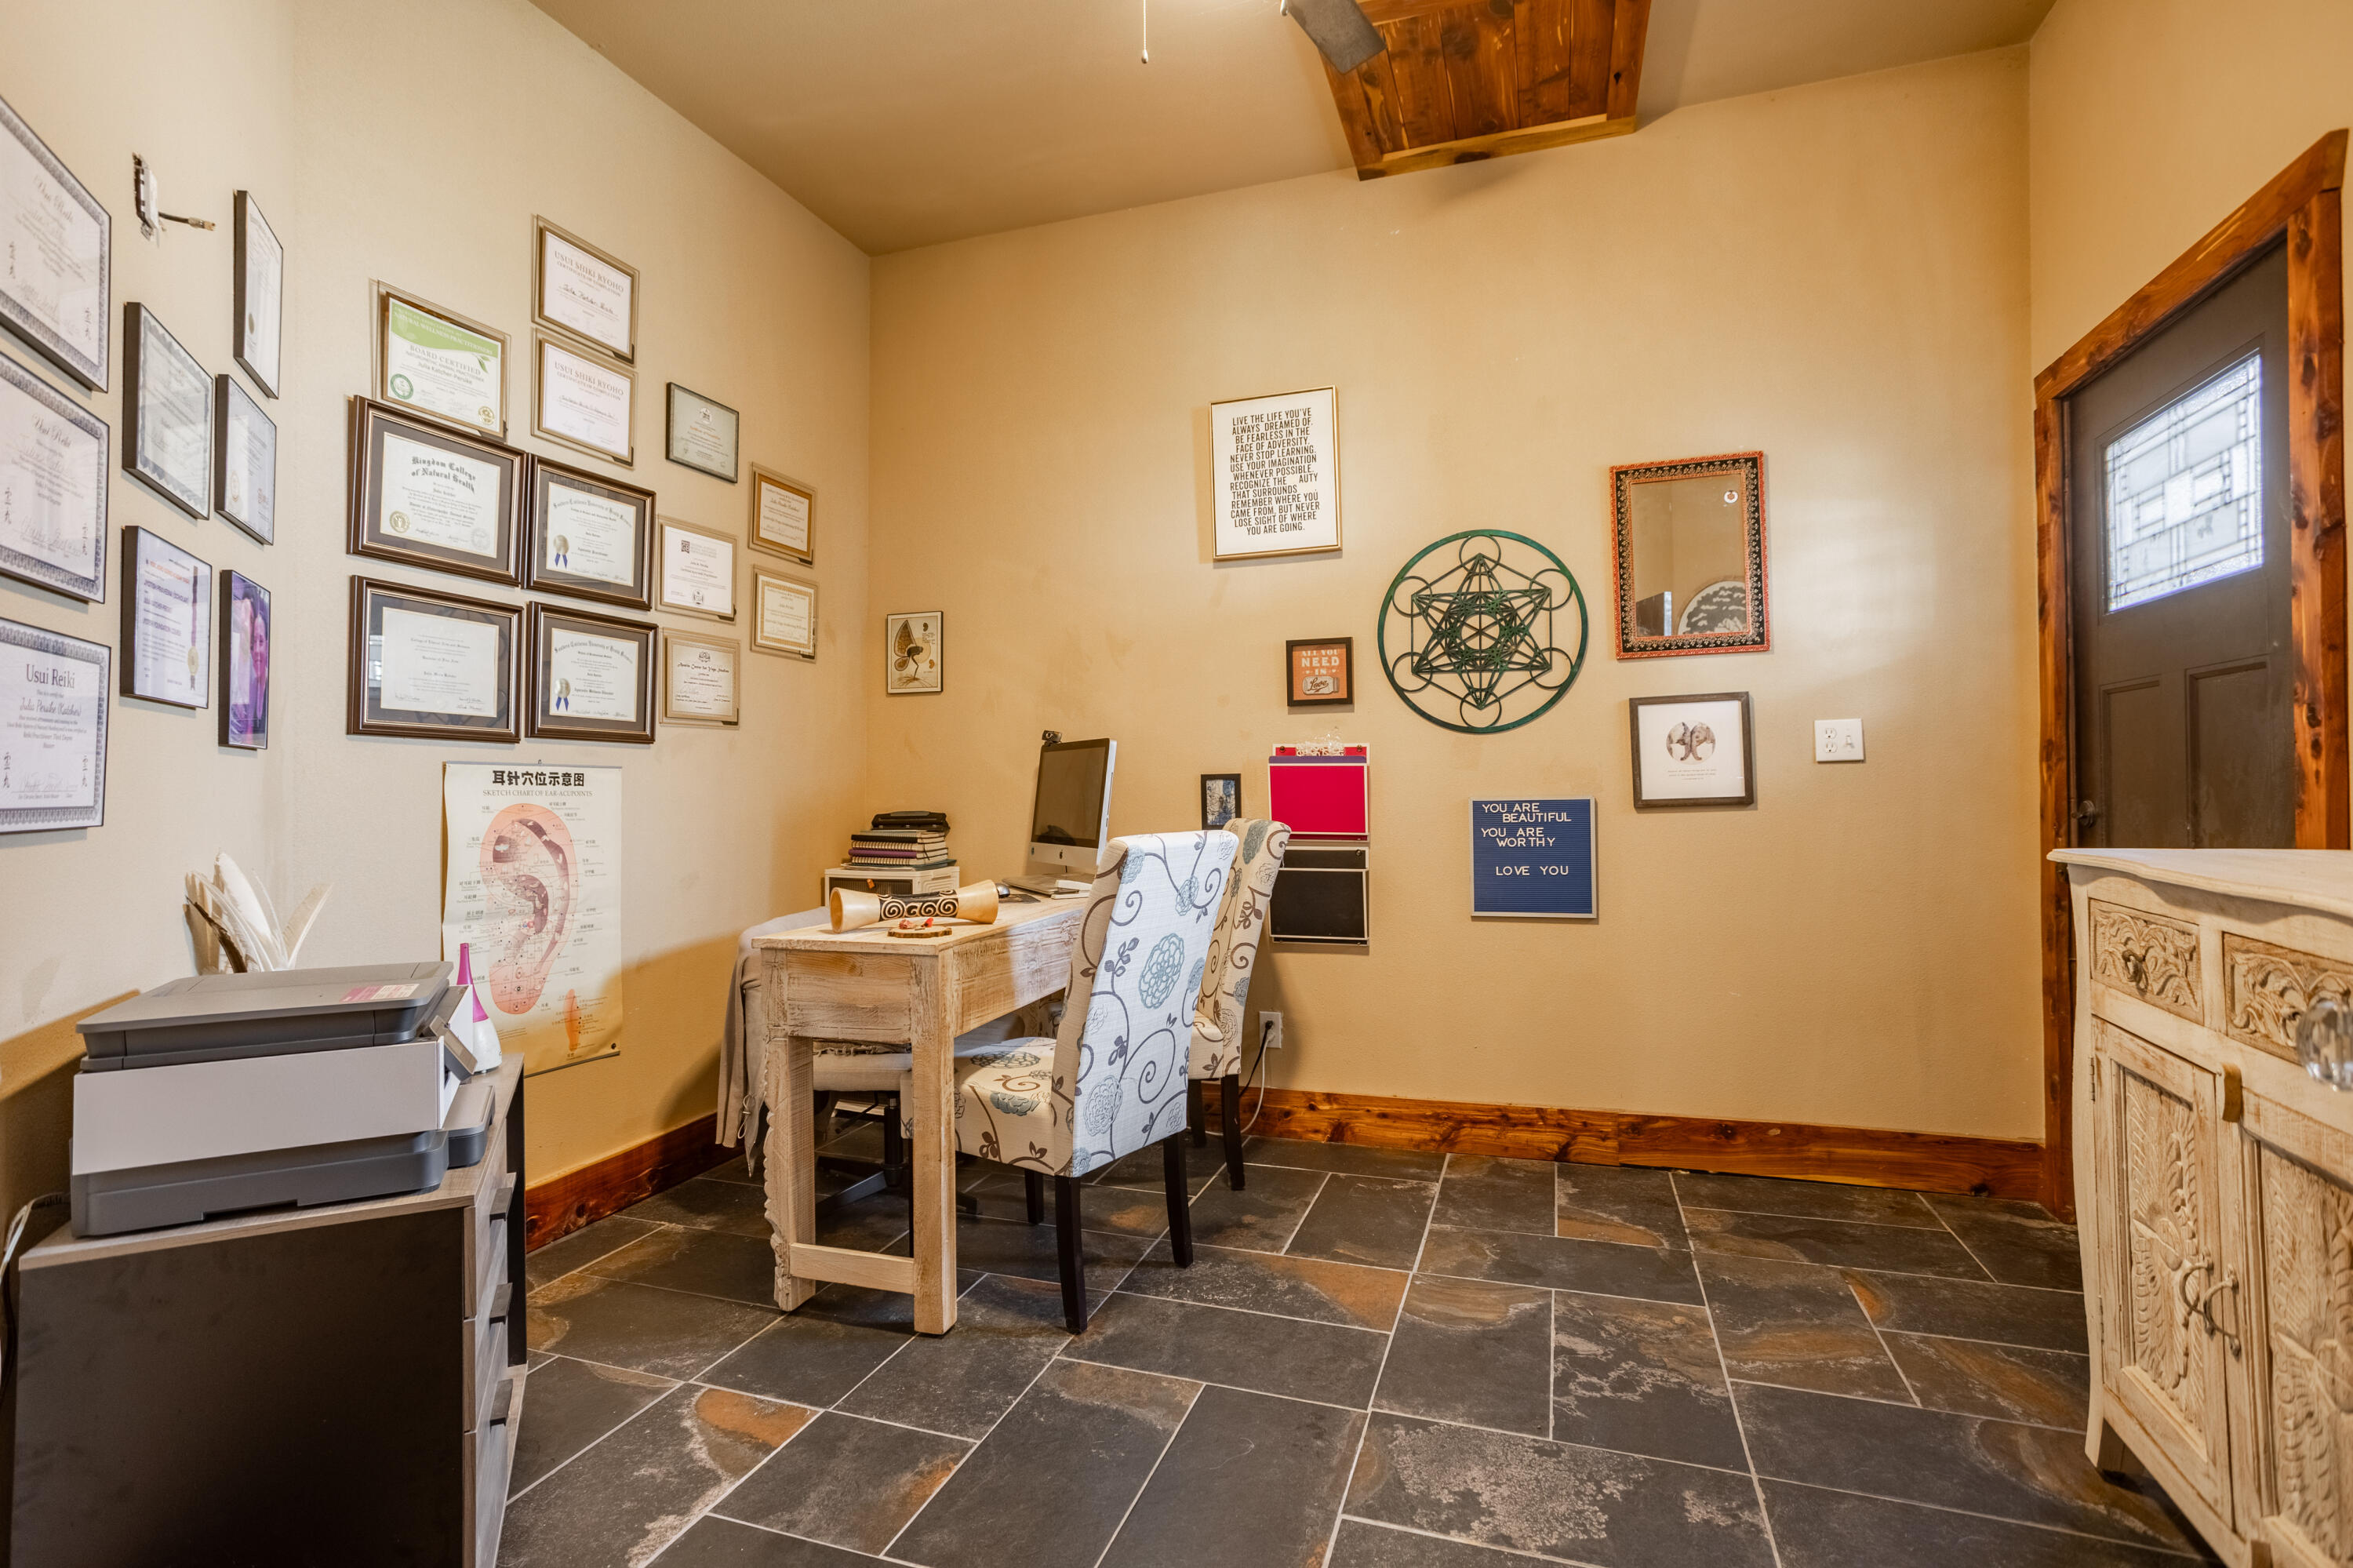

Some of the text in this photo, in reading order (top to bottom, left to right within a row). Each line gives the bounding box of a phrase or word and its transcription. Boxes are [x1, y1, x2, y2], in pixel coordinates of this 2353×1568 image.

[555, 250, 624, 293] USUI SHIKI RYOHO
[409, 345, 482, 376] BOARD CERTIFIED
[555, 361, 624, 396] USUI SHIKI RYOHO
[1232, 407, 1311, 426] LIVE THE LIFE YOU'VE
[1231, 424, 1260, 435] ALWAYS
[1264, 418, 1300, 431] DREAMED
[1235, 427, 1310, 444] BE FEARLESS IN THE
[1231, 445, 1316, 463] NEVER STOP LEARNING.
[1236, 442, 1253, 453] FACE
[1256, 442, 1264, 450] OF
[1231, 454, 1316, 472] USE YOUR IMAGINATION
[1233, 464, 1314, 481] WHENEVER POSSIBLE.
[1231, 478, 1270, 490] RECOGNIZE
[1272, 476, 1286, 486] THE
[1231, 492, 1318, 509] REMEMBER WHERE YOU
[1232, 485, 1297, 500] THAT SURROUNDS
[1231, 508, 1250, 518] CAME
[1278, 504, 1293, 514] BUT
[1296, 501, 1319, 511] NEVER
[1235, 511, 1317, 527] LOSE SIGHT OF WHERE
[1246, 522, 1304, 535] YOU ARE GOING.
[1302, 657, 1340, 667] NEED
[26, 664, 75, 689] Usui Reiki
[1307, 677, 1329, 692] Love
[493, 770, 584, 786] 耳针穴位示意图
[1482, 802, 1540, 813] YOU ARE
[1503, 813, 1572, 823] BEAUTIFUL
[1481, 827, 1544, 838] YOU ARE
[1497, 838, 1555, 847] WORTHY
[1496, 866, 1569, 875] LOVE YOU
